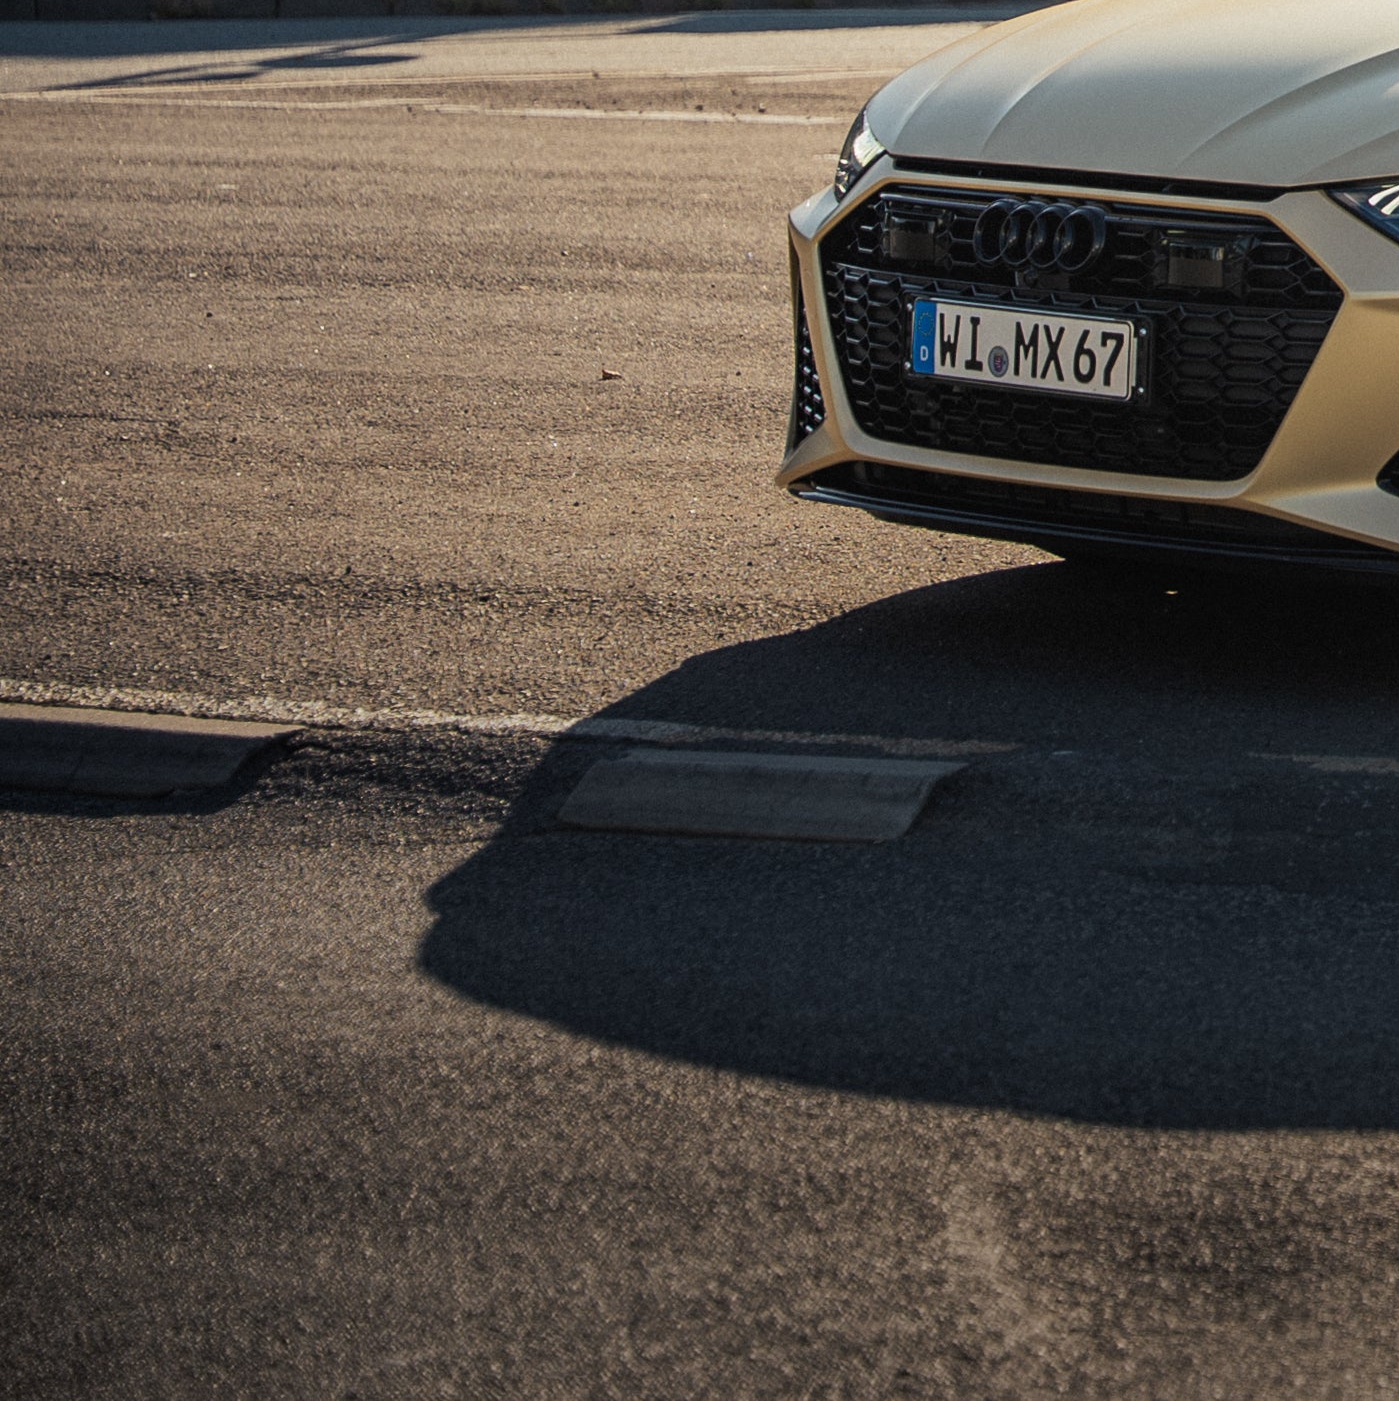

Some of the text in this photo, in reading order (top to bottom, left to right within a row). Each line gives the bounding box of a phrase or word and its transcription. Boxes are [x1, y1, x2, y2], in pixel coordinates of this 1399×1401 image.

[919, 345, 930, 363] D
[938, 312, 1125, 387] WI MX 67
